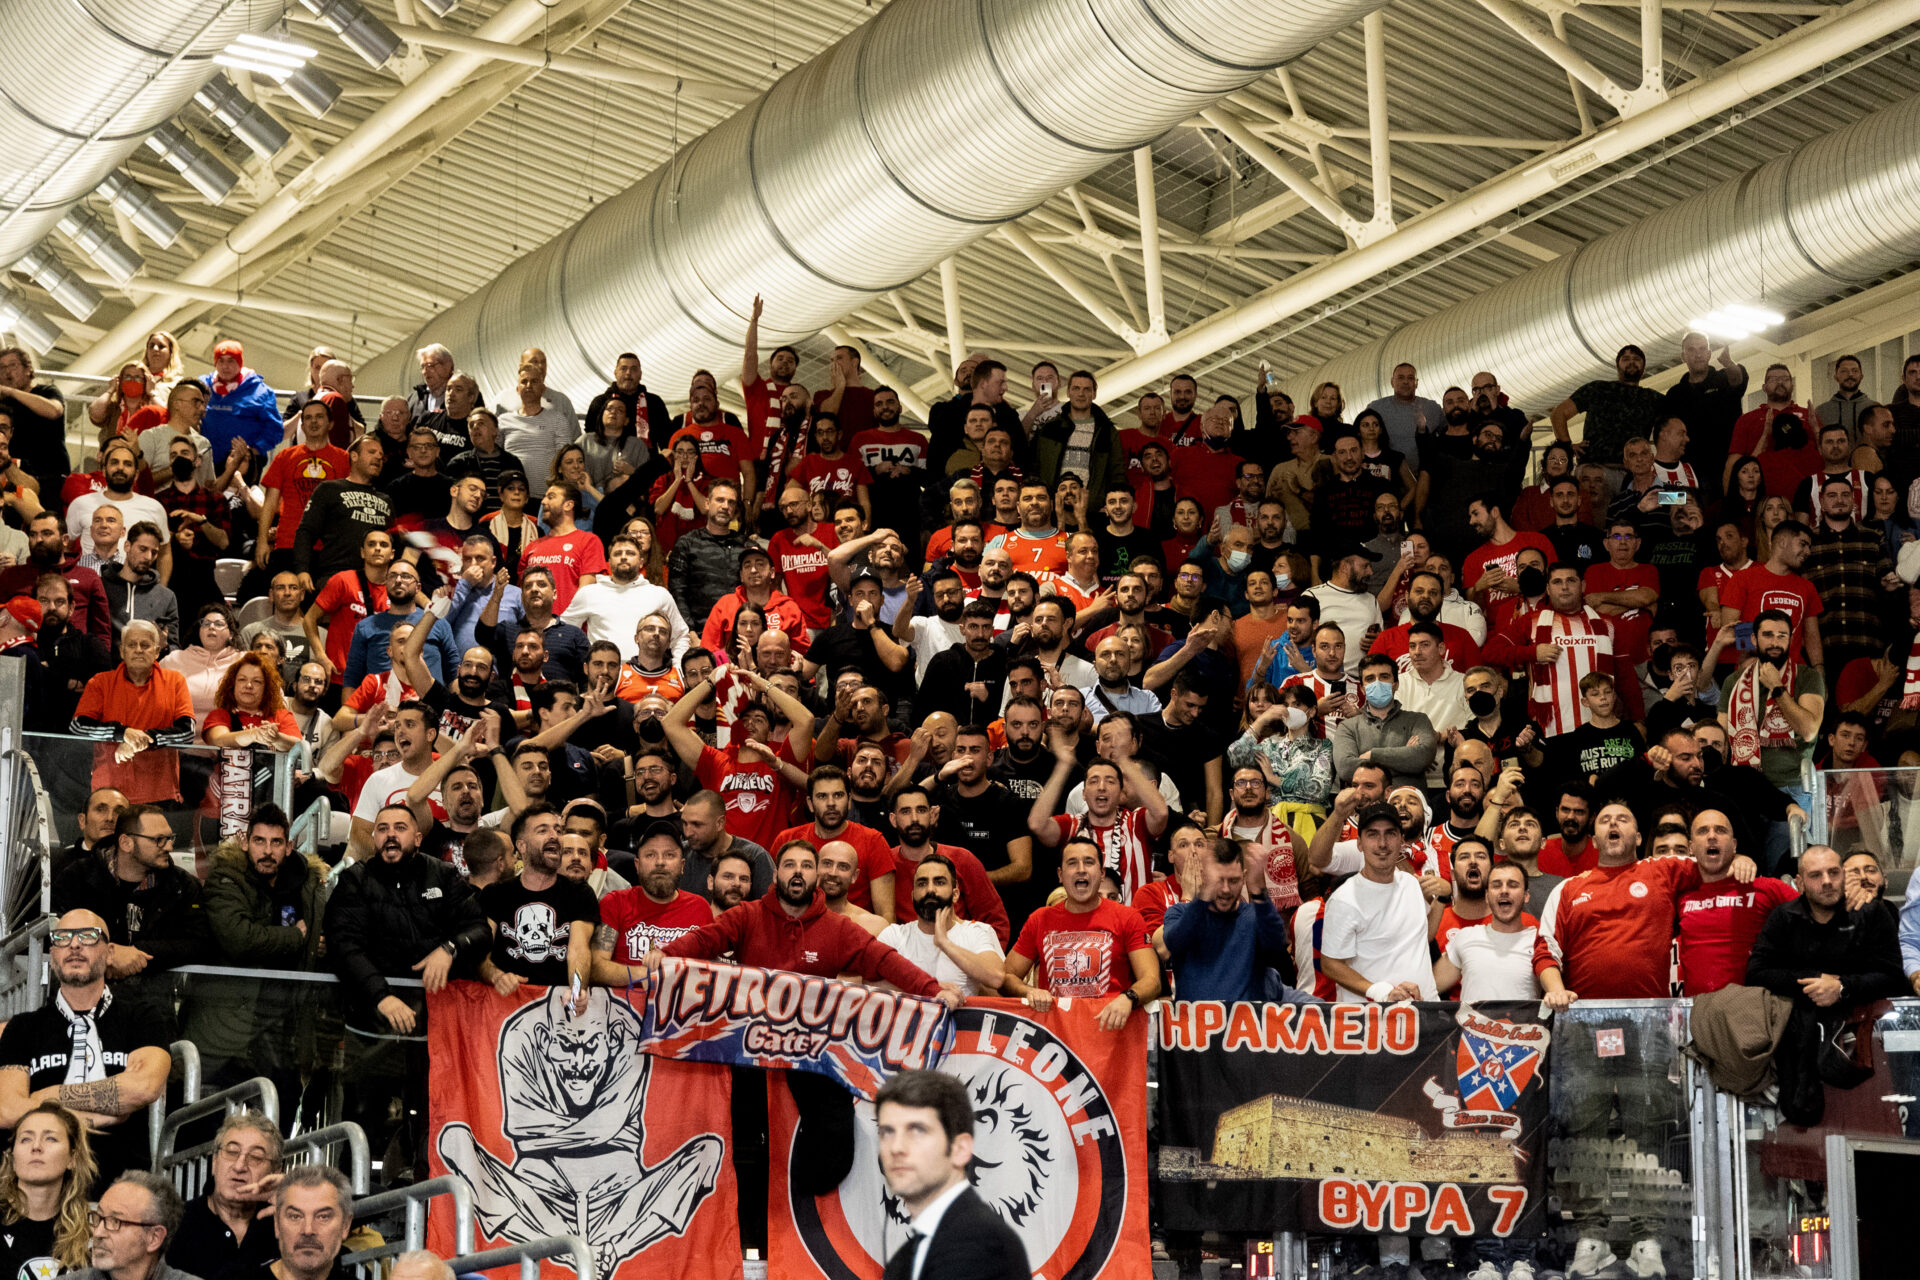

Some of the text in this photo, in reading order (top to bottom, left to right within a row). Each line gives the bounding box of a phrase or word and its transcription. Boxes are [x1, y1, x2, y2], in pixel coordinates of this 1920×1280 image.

[866, 447, 915, 464] FILA
[1032, 548, 1043, 562] 7
[1769, 597, 1800, 607] LEGEND
[1581, 759, 1599, 772] THE
[1159, 1001, 1420, 1055] ΗΡΑΚΛΕΙΟ
[30, 1052, 128, 1076] LAC BA
[977, 1013, 1115, 1147] LEONE
[1319, 1178, 1528, 1238] ΘΥΡΑ 7
